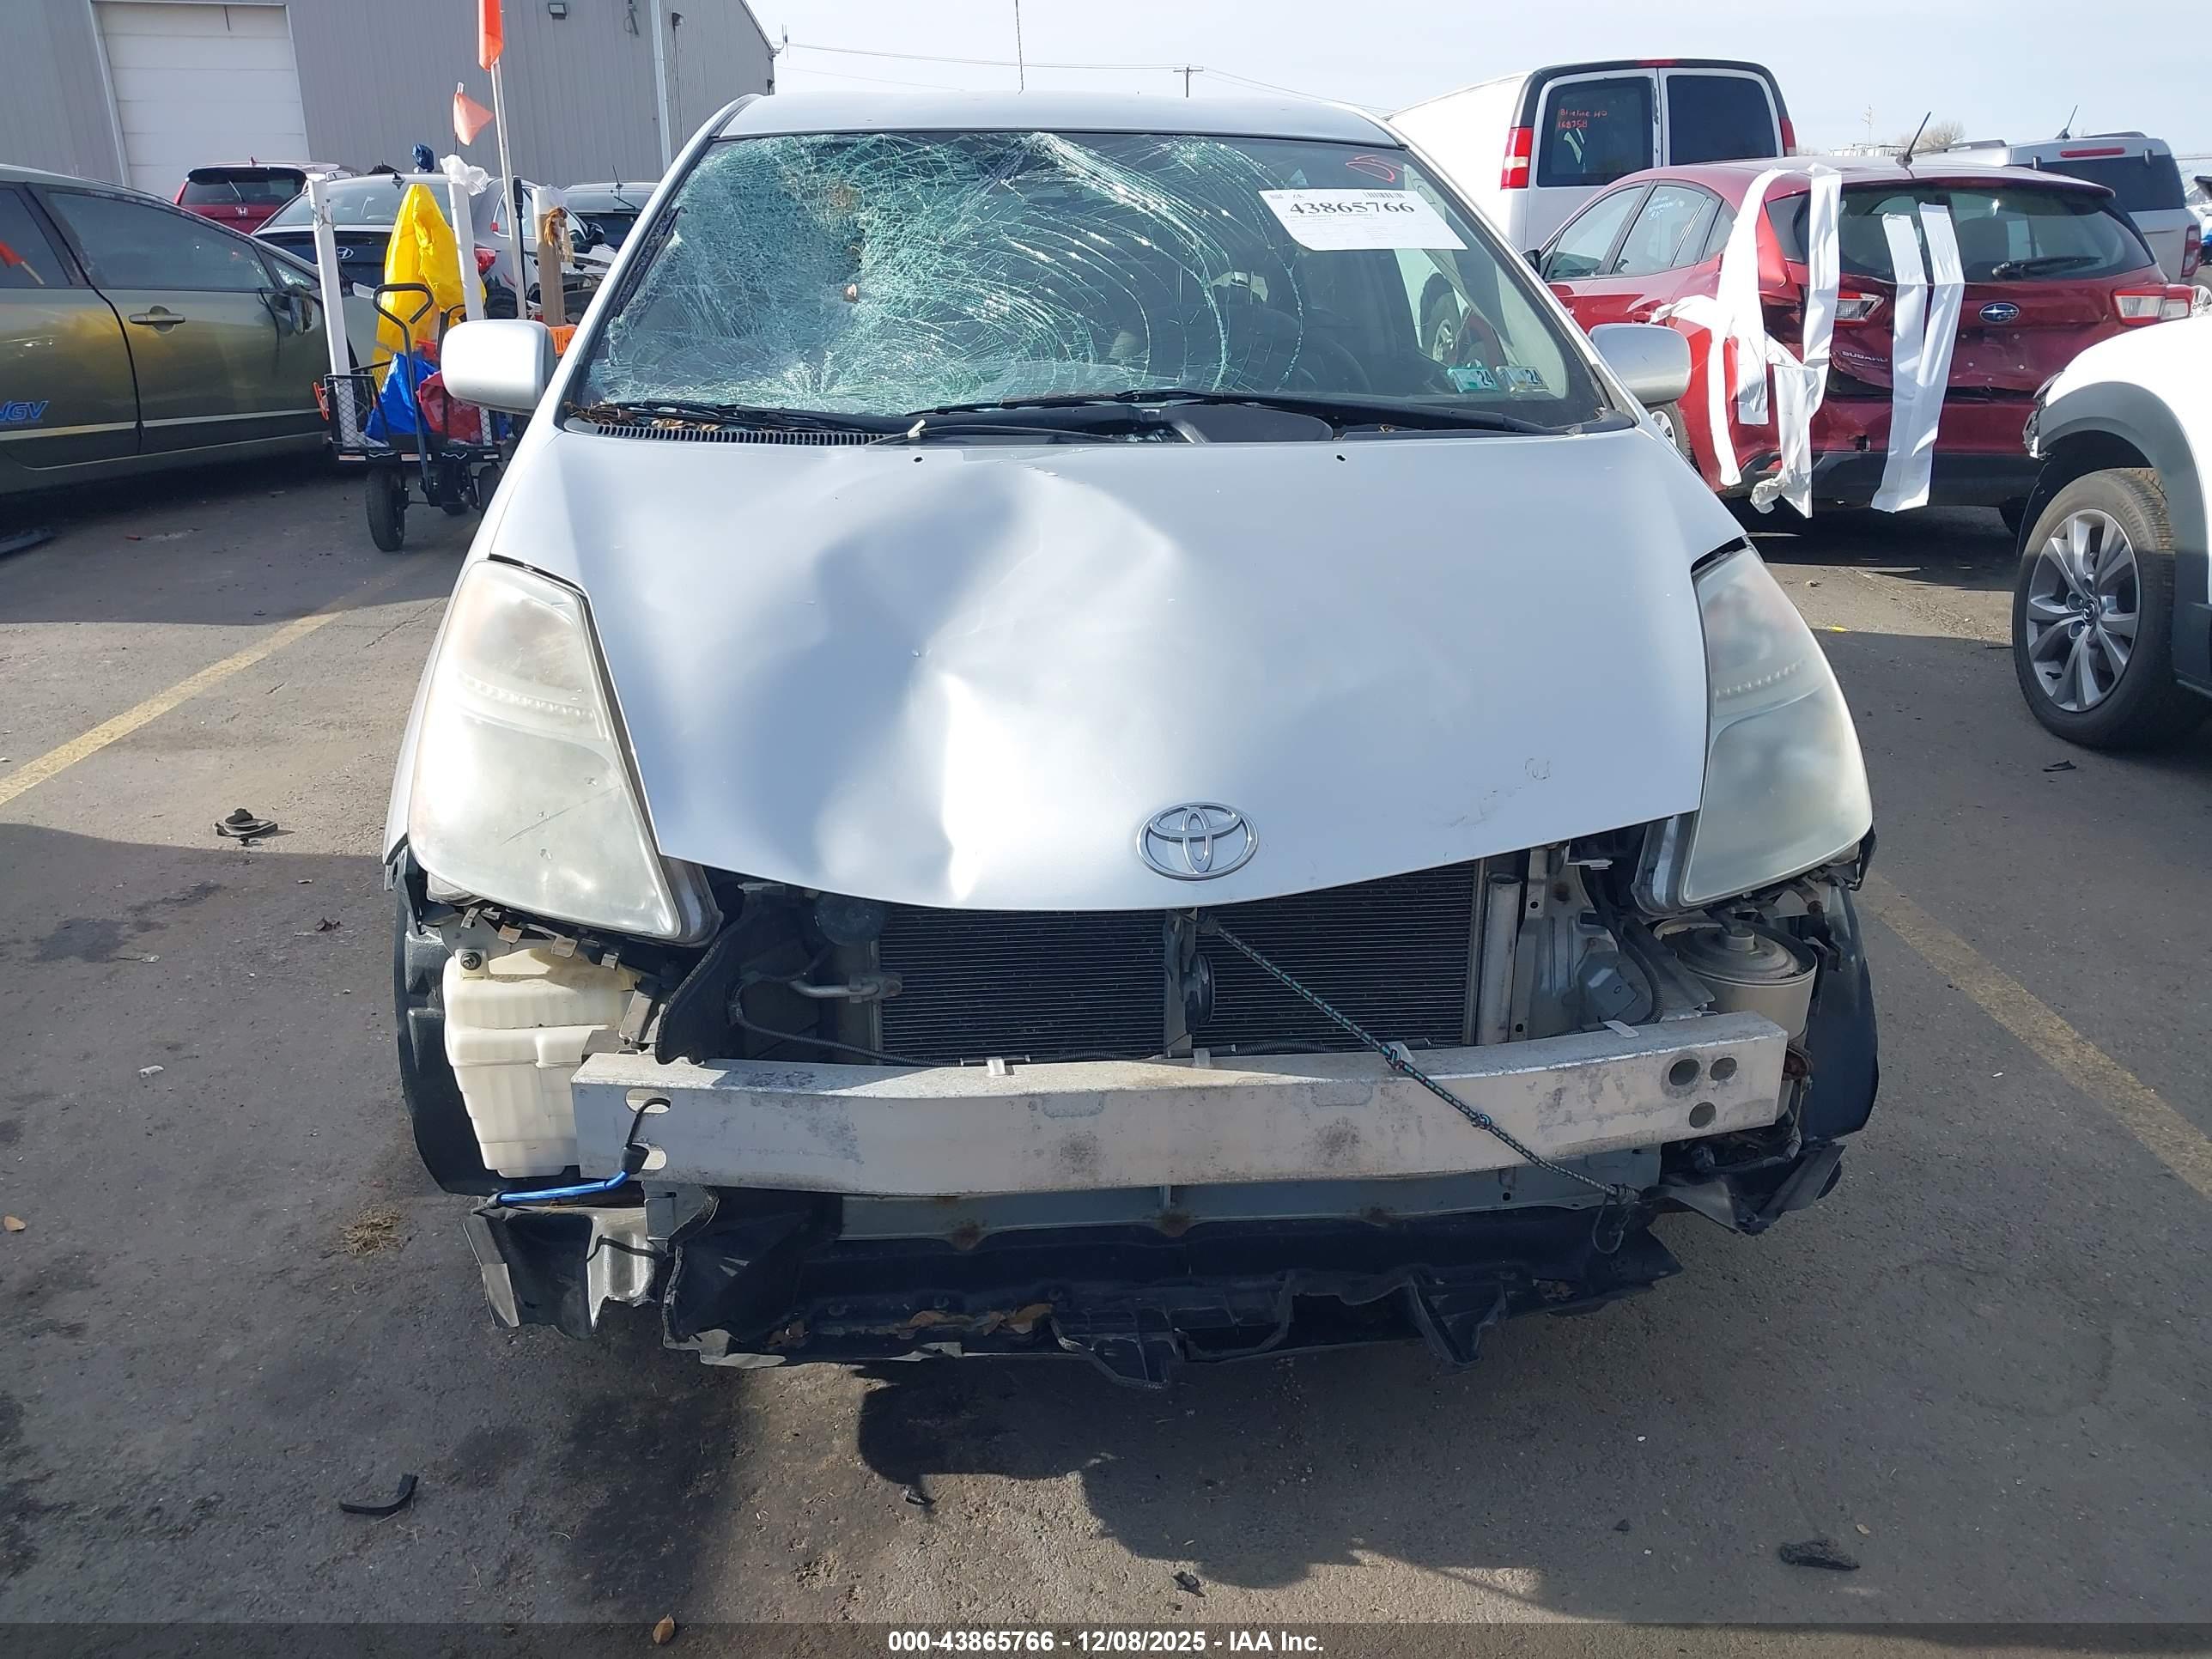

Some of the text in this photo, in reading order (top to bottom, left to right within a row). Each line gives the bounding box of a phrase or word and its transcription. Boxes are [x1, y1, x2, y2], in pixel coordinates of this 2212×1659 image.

[1290, 201, 1415, 215] 43865766
[1476, 370, 1495, 386] 24
[1524, 369, 1544, 386] 24
